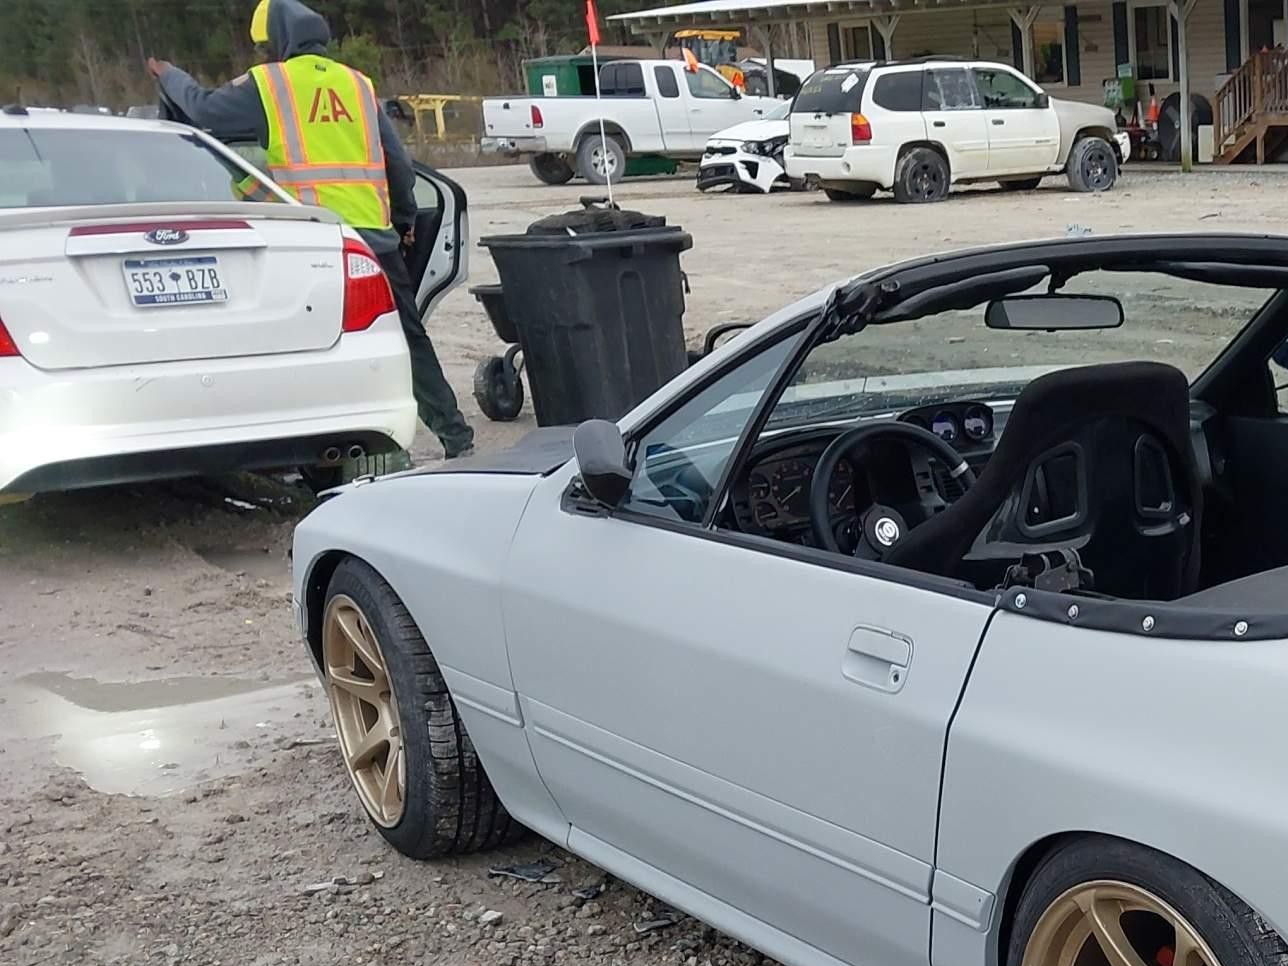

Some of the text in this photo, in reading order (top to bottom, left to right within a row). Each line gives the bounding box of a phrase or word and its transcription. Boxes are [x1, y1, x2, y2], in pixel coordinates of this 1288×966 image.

[155, 229, 180, 241] Ford
[131, 268, 221, 294] 553 BZB
[155, 294, 176, 303] SOUTH
